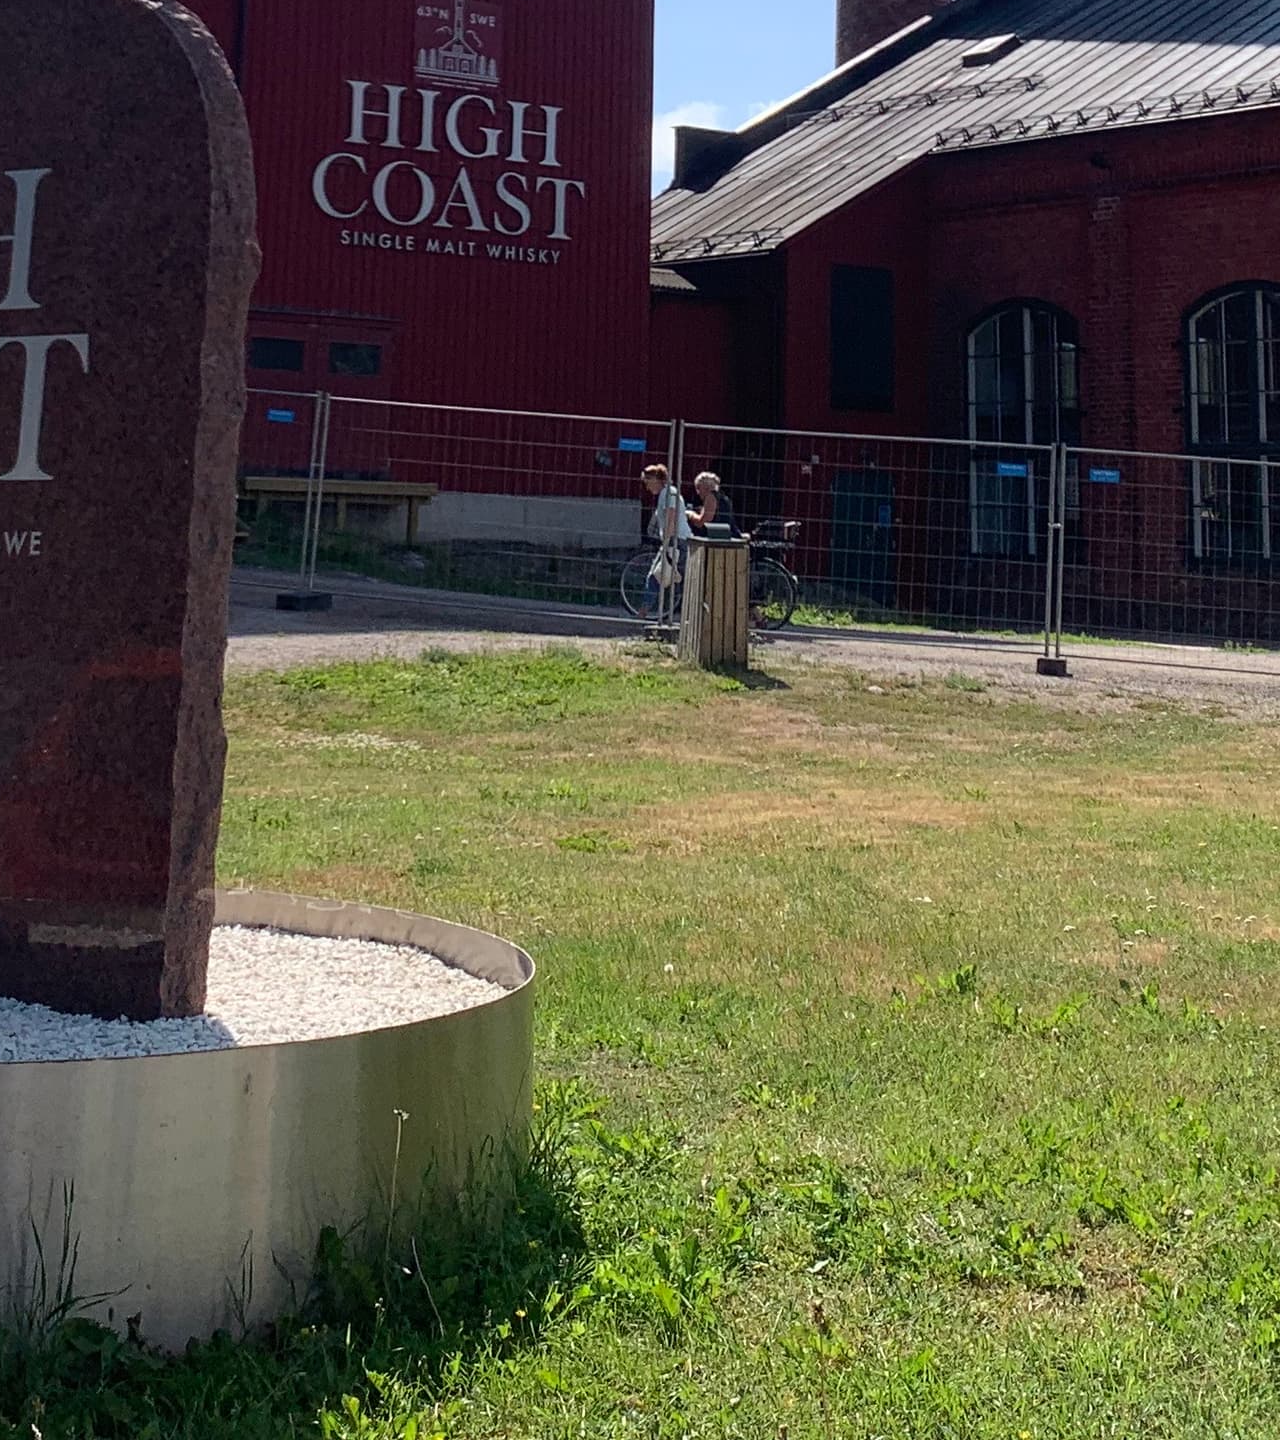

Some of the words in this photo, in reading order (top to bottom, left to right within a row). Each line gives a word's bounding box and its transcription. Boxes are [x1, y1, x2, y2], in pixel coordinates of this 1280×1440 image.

[469, 13, 496, 28] SWE
[344, 79, 563, 167] HIGH
[312, 152, 585, 240] COAST
[340, 229, 416, 251] SINGLE
[425, 238, 476, 257] MALT
[486, 243, 561, 265] WHISKY
